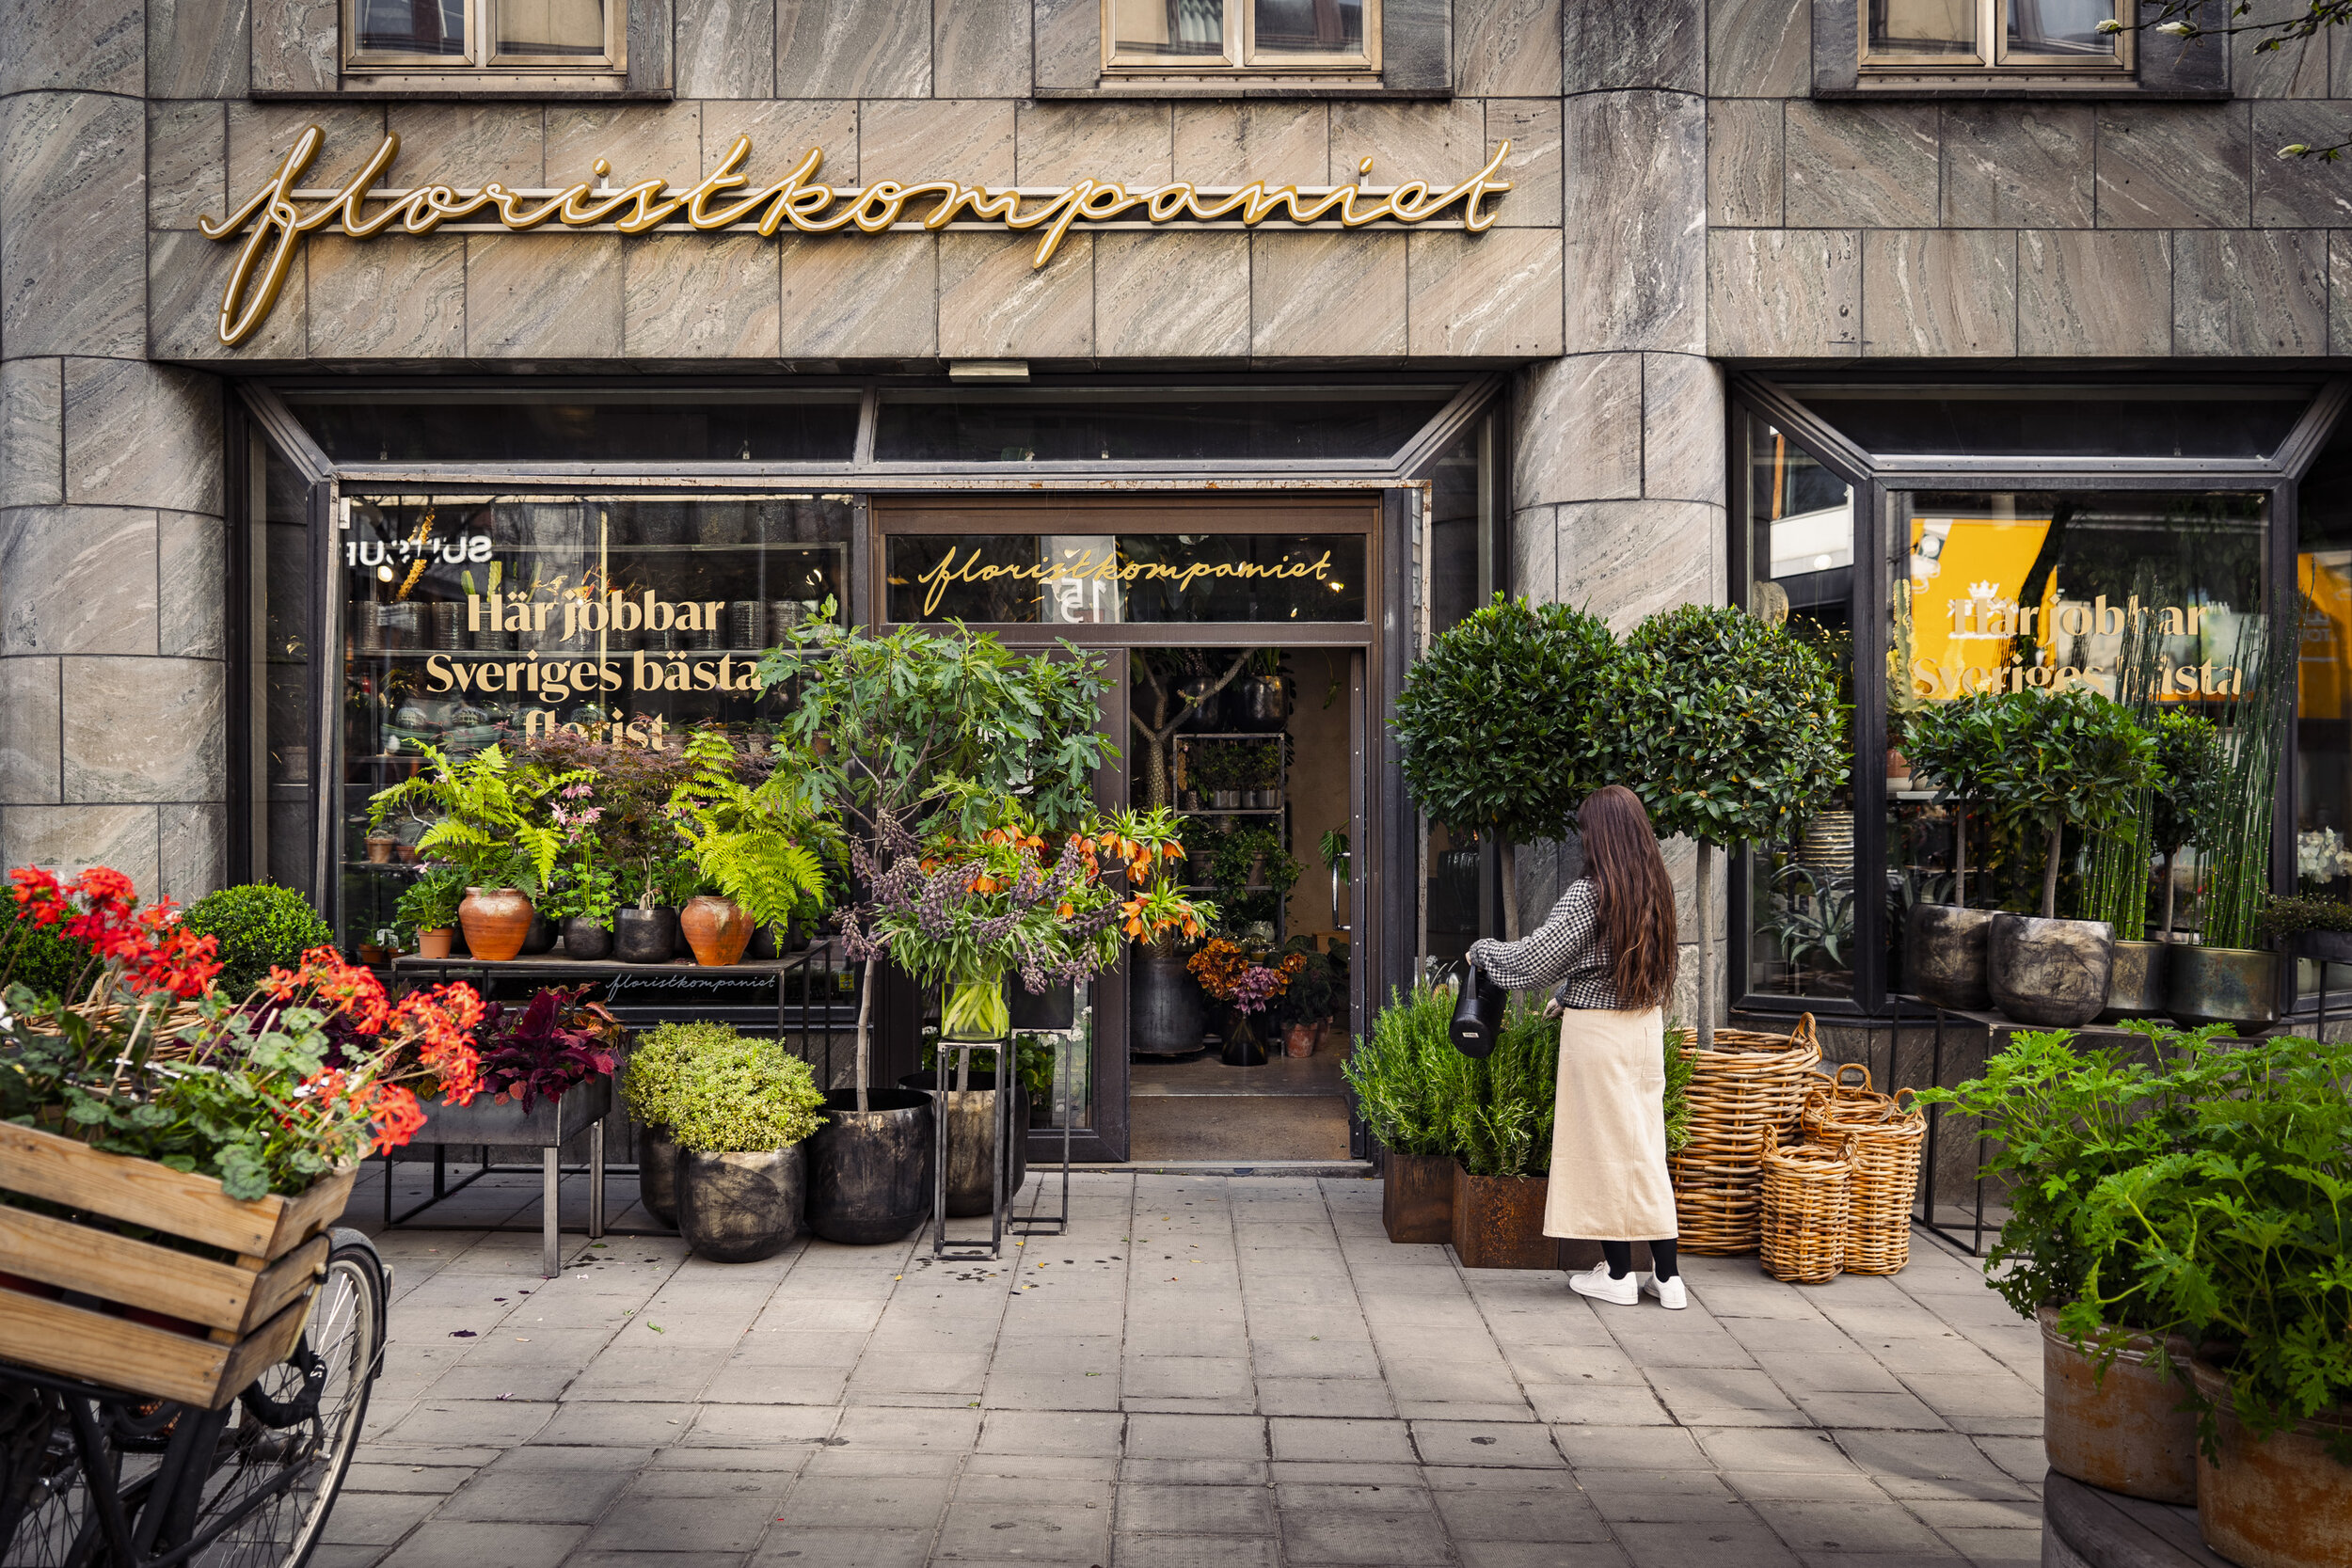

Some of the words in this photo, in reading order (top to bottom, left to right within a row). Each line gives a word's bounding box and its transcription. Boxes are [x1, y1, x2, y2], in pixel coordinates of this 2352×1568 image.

[199, 124, 1514, 348] floristkompaniet
[918, 546, 1332, 617] floristkompaniet
[468, 591, 555, 633] Här
[559, 588, 726, 642] jobbar
[1954, 594, 2041, 636] Här
[426, 649, 622, 704] Sveriges
[633, 649, 765, 692] bästa
[522, 706, 670, 752] florist
[605, 973, 776, 1003] floristkompaniet
